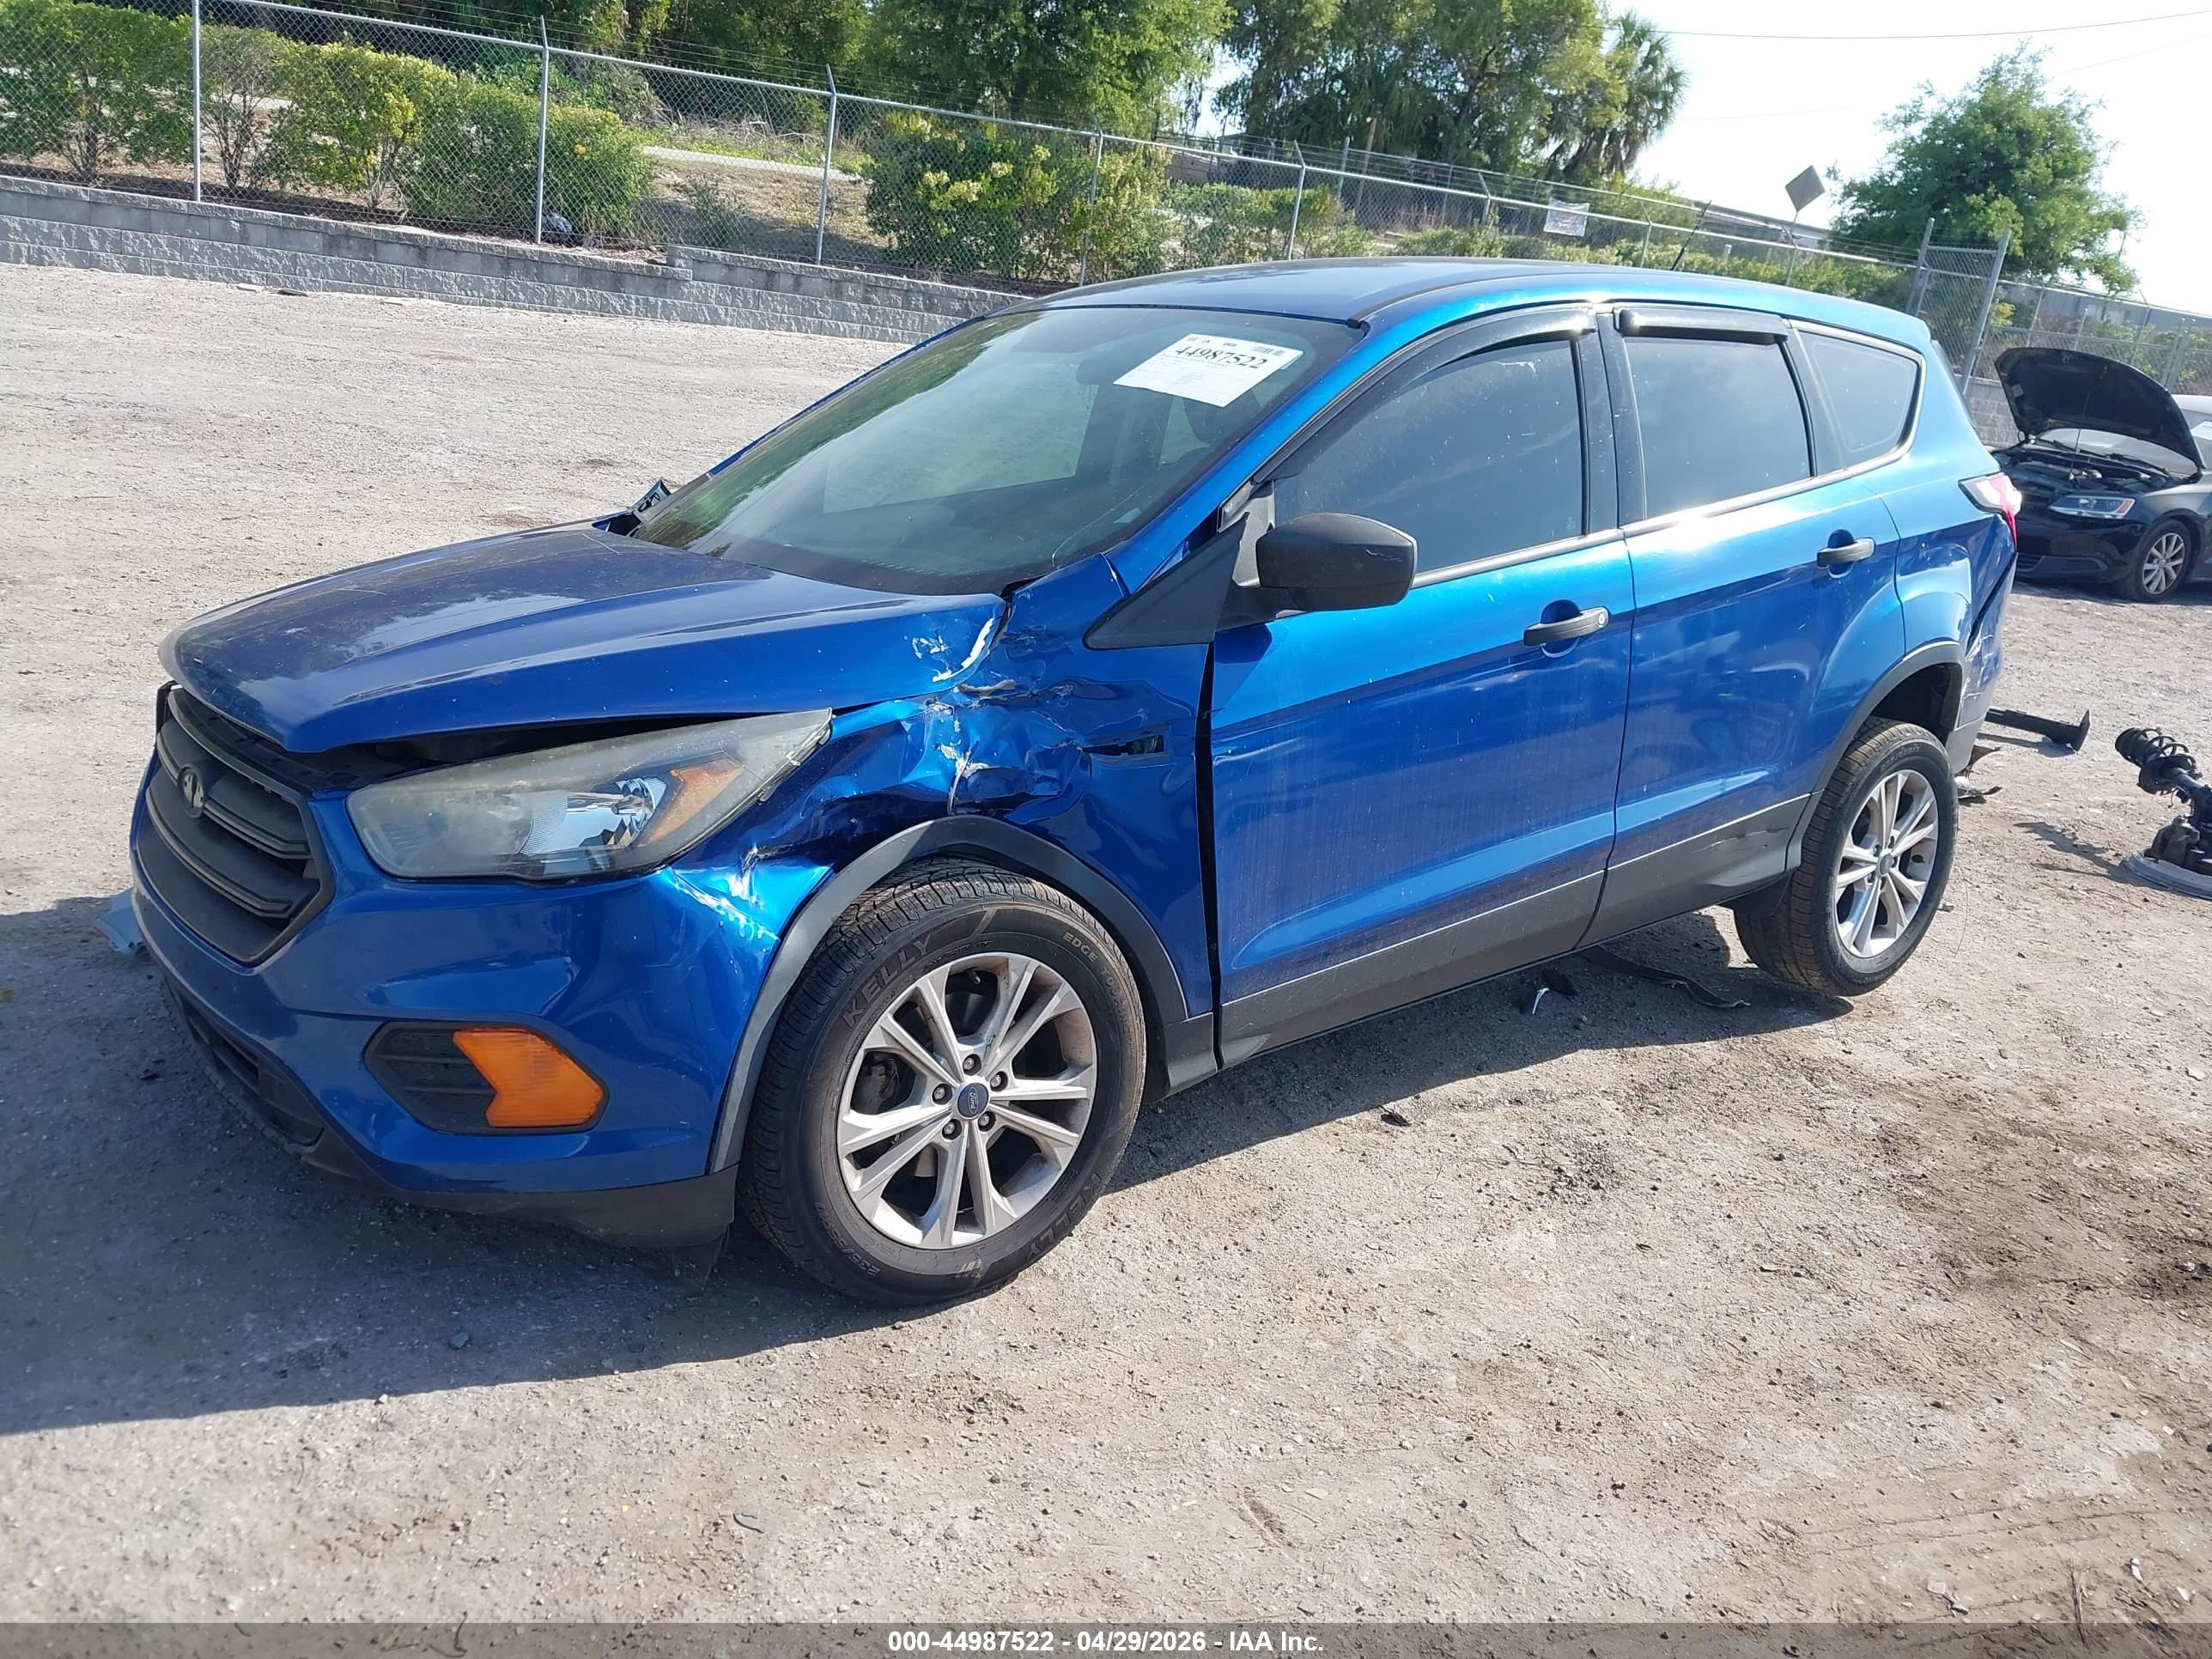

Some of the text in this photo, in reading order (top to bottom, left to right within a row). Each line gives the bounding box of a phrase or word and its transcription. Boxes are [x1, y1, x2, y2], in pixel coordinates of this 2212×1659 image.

[1176, 346, 1267, 368] 44987522
[1062, 932, 1099, 963] EDGE
[842, 934, 932, 1028] KELLY
[1027, 1170, 1101, 1258] KELLY
